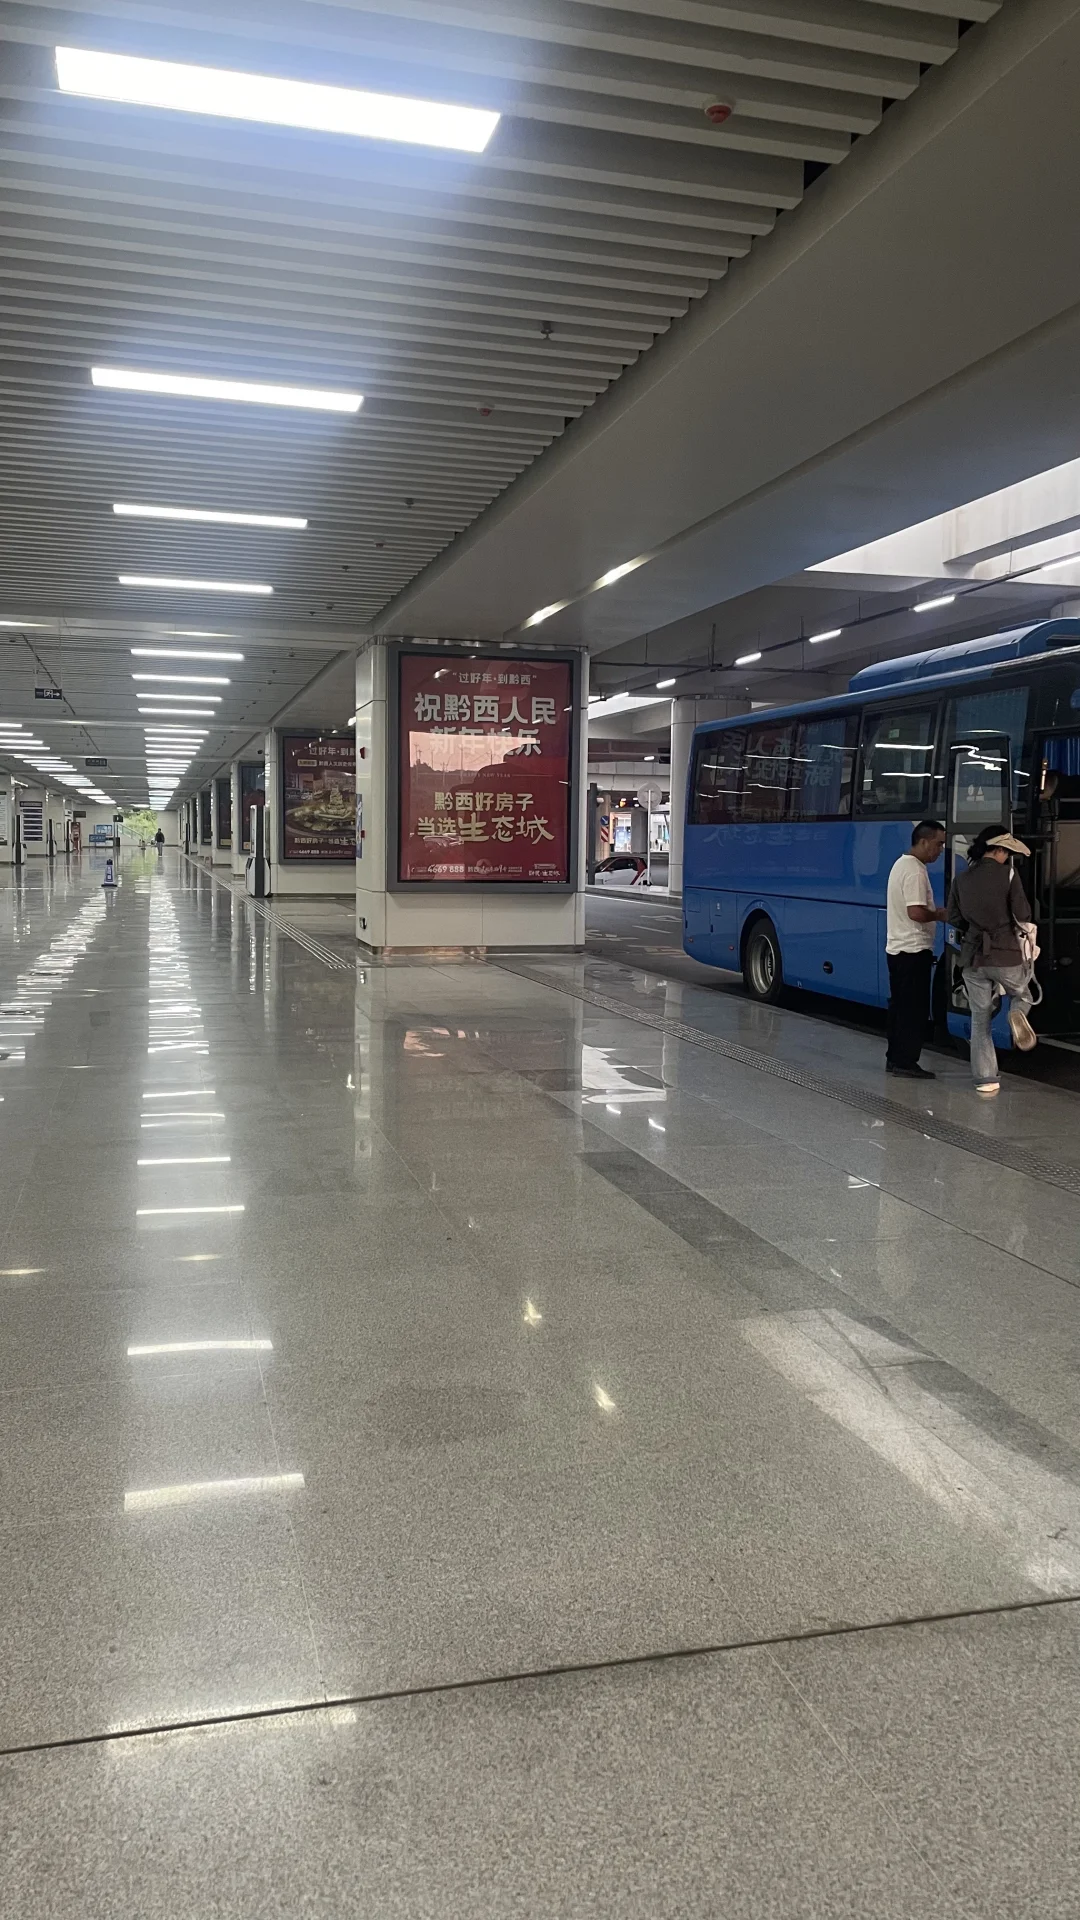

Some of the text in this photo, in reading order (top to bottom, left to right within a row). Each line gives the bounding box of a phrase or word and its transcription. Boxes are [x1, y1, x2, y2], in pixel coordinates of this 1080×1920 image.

[414, 692, 557, 725] 祝黔西人民
[429, 726, 542, 757] 新年快乐
[434, 791, 534, 812] 黔西好房子
[417, 812, 555, 845] 当选生态城
[428, 864, 447, 873] 4669
[449, 865, 465, 873] 888
